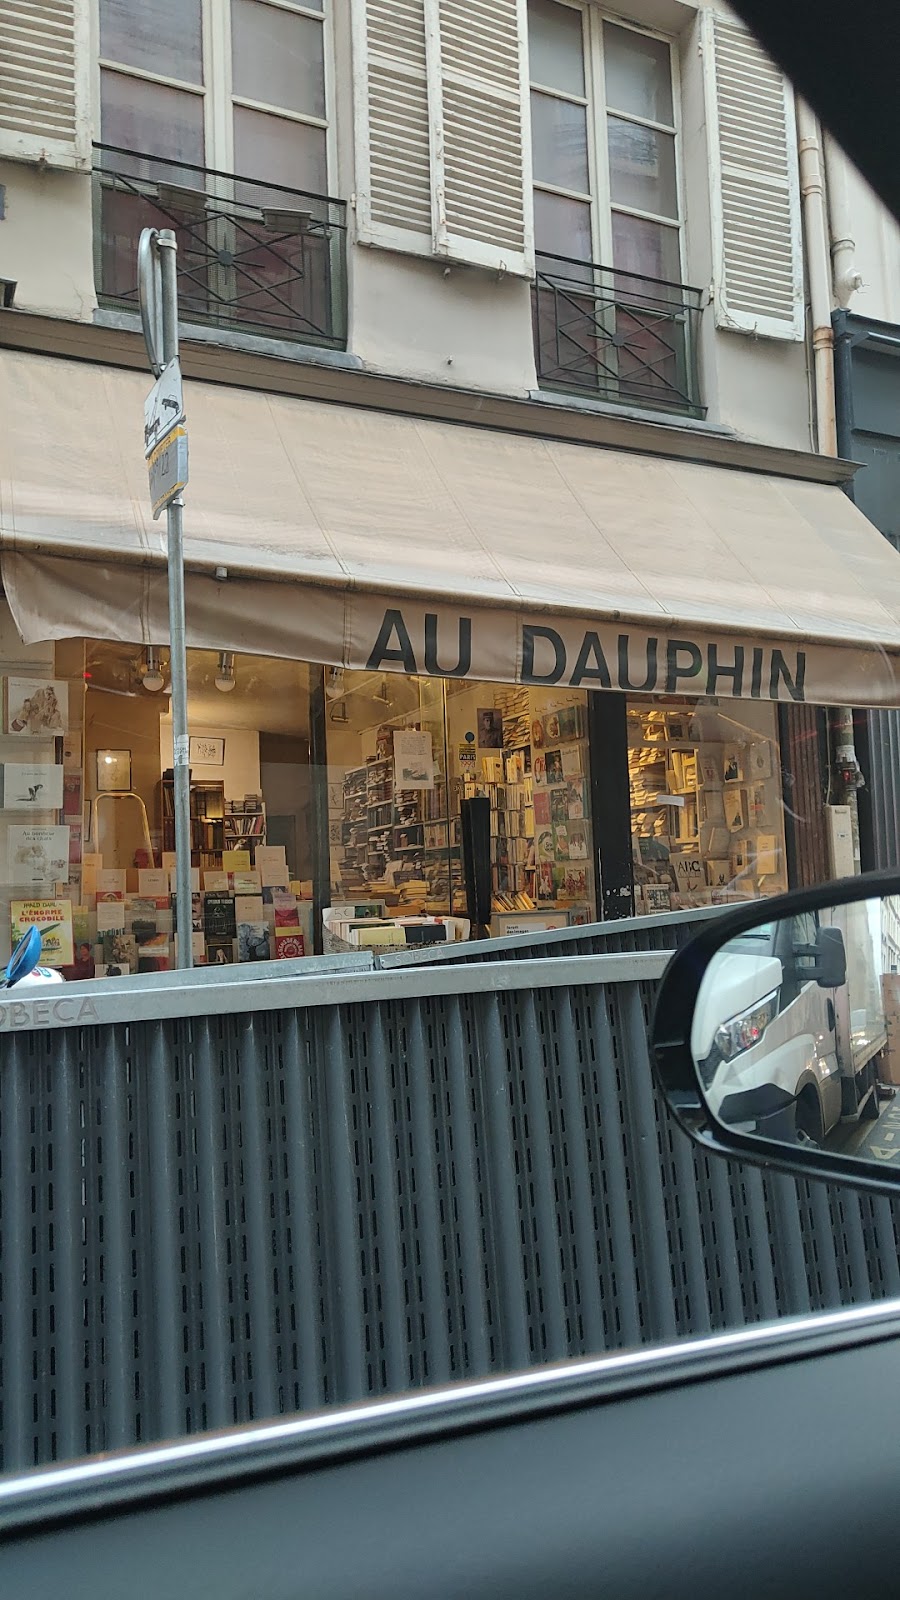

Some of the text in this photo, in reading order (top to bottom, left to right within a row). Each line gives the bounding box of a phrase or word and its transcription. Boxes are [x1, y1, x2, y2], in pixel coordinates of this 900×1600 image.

[366, 609, 806, 702] AU DAUPHIN
[394, 948, 446, 965] SOBECA
